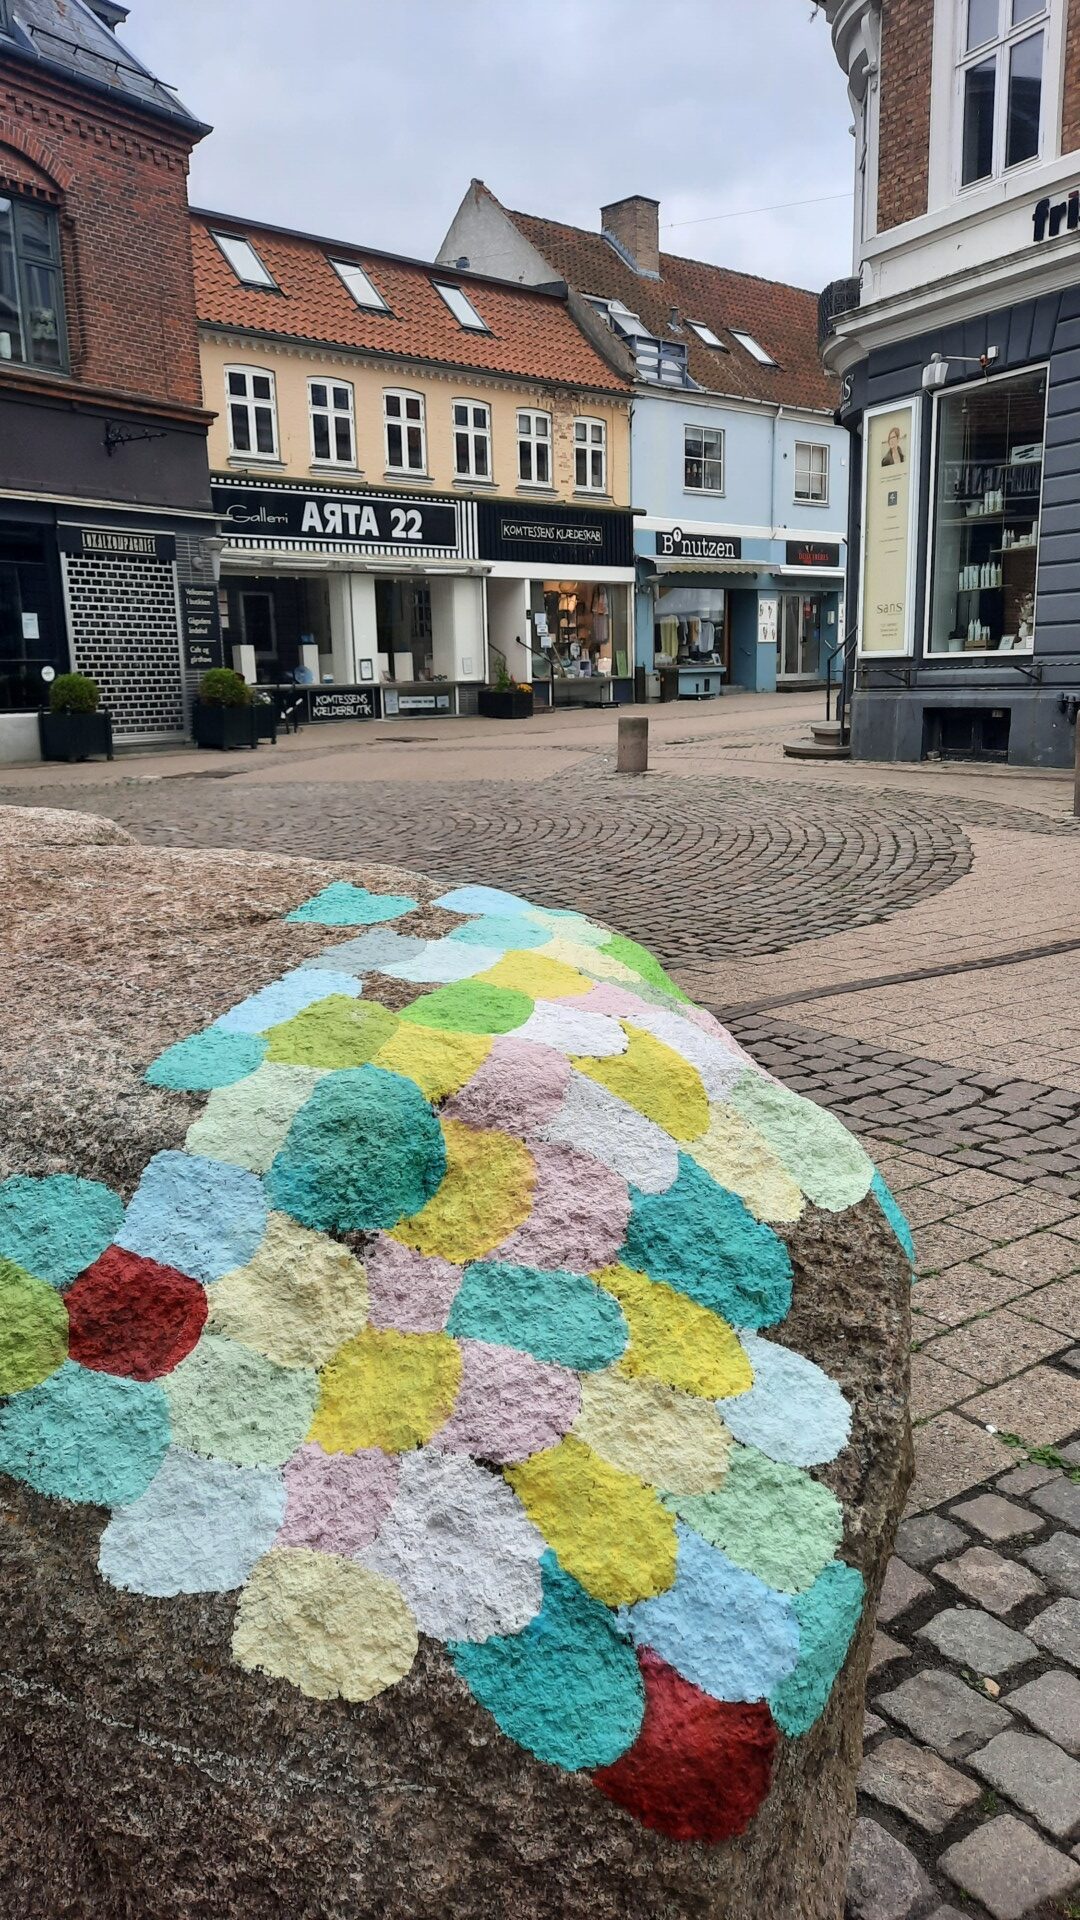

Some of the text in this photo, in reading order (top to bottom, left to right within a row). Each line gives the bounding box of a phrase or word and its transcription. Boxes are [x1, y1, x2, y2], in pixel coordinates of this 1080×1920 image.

[1032, 190, 1080, 242] fri
[226, 504, 289, 524] Galleri
[390, 508, 423, 540] 22
[503, 525, 555, 539] KOMTESSENS
[876, 602, 904, 615] sans
[315, 693, 368, 707] KOMTESSENS
